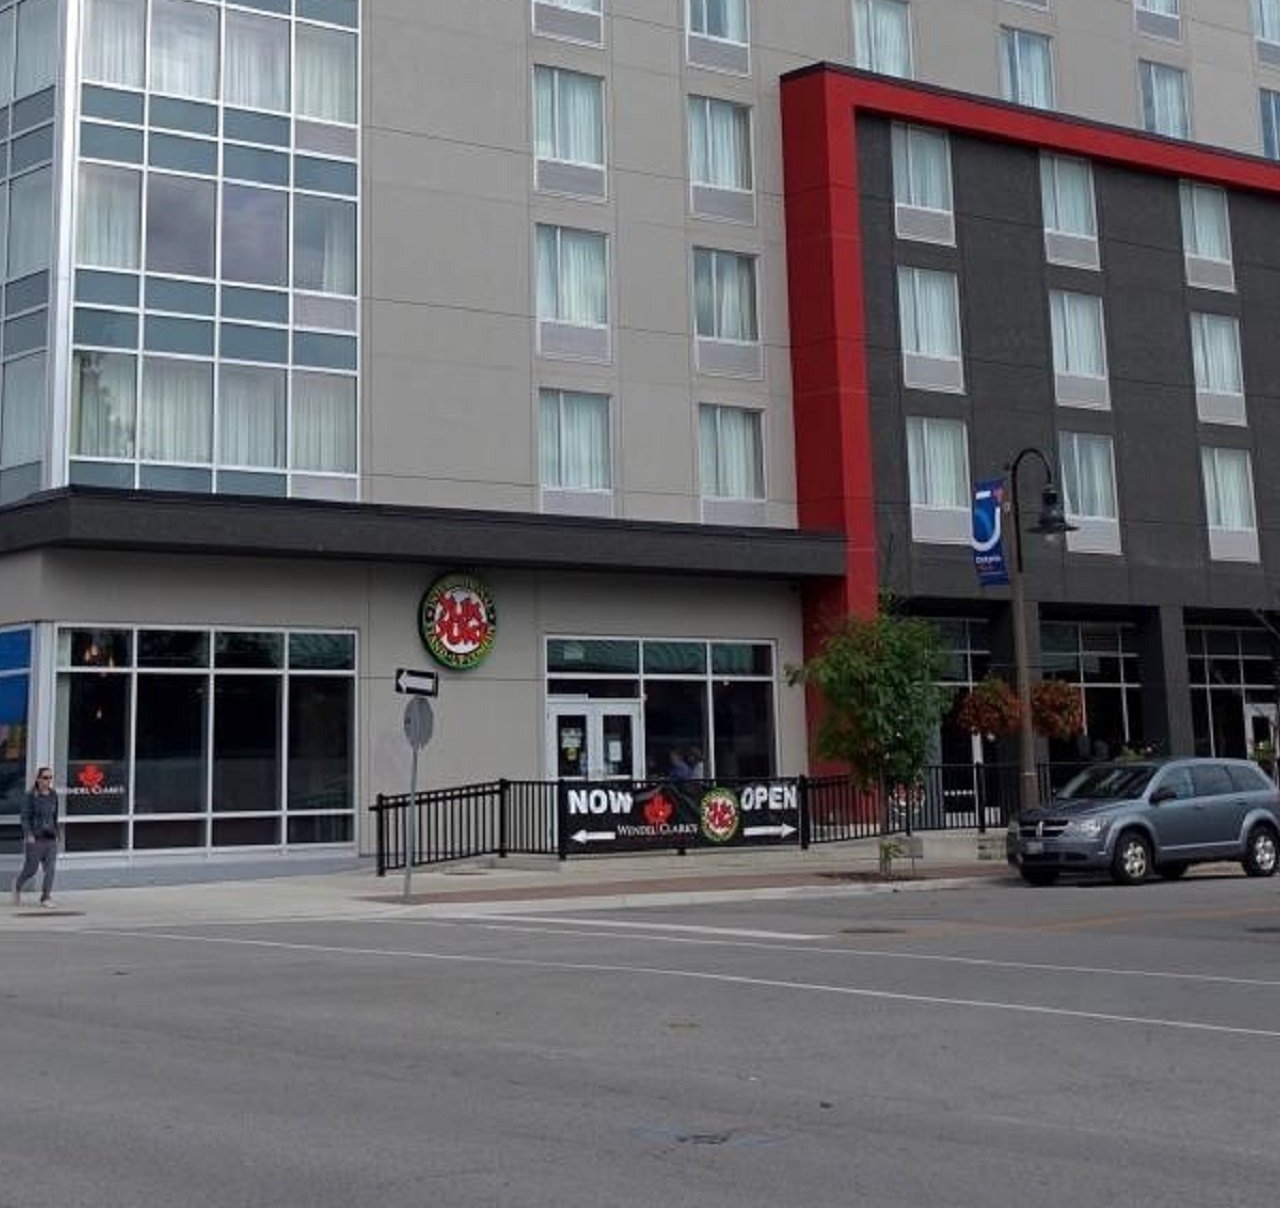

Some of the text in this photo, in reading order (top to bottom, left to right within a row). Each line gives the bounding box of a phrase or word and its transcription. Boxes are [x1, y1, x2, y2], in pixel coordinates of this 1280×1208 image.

[567, 789, 634, 815] NOW
[740, 785, 798, 812] OPEN
[617, 824, 655, 836] WENDEL
